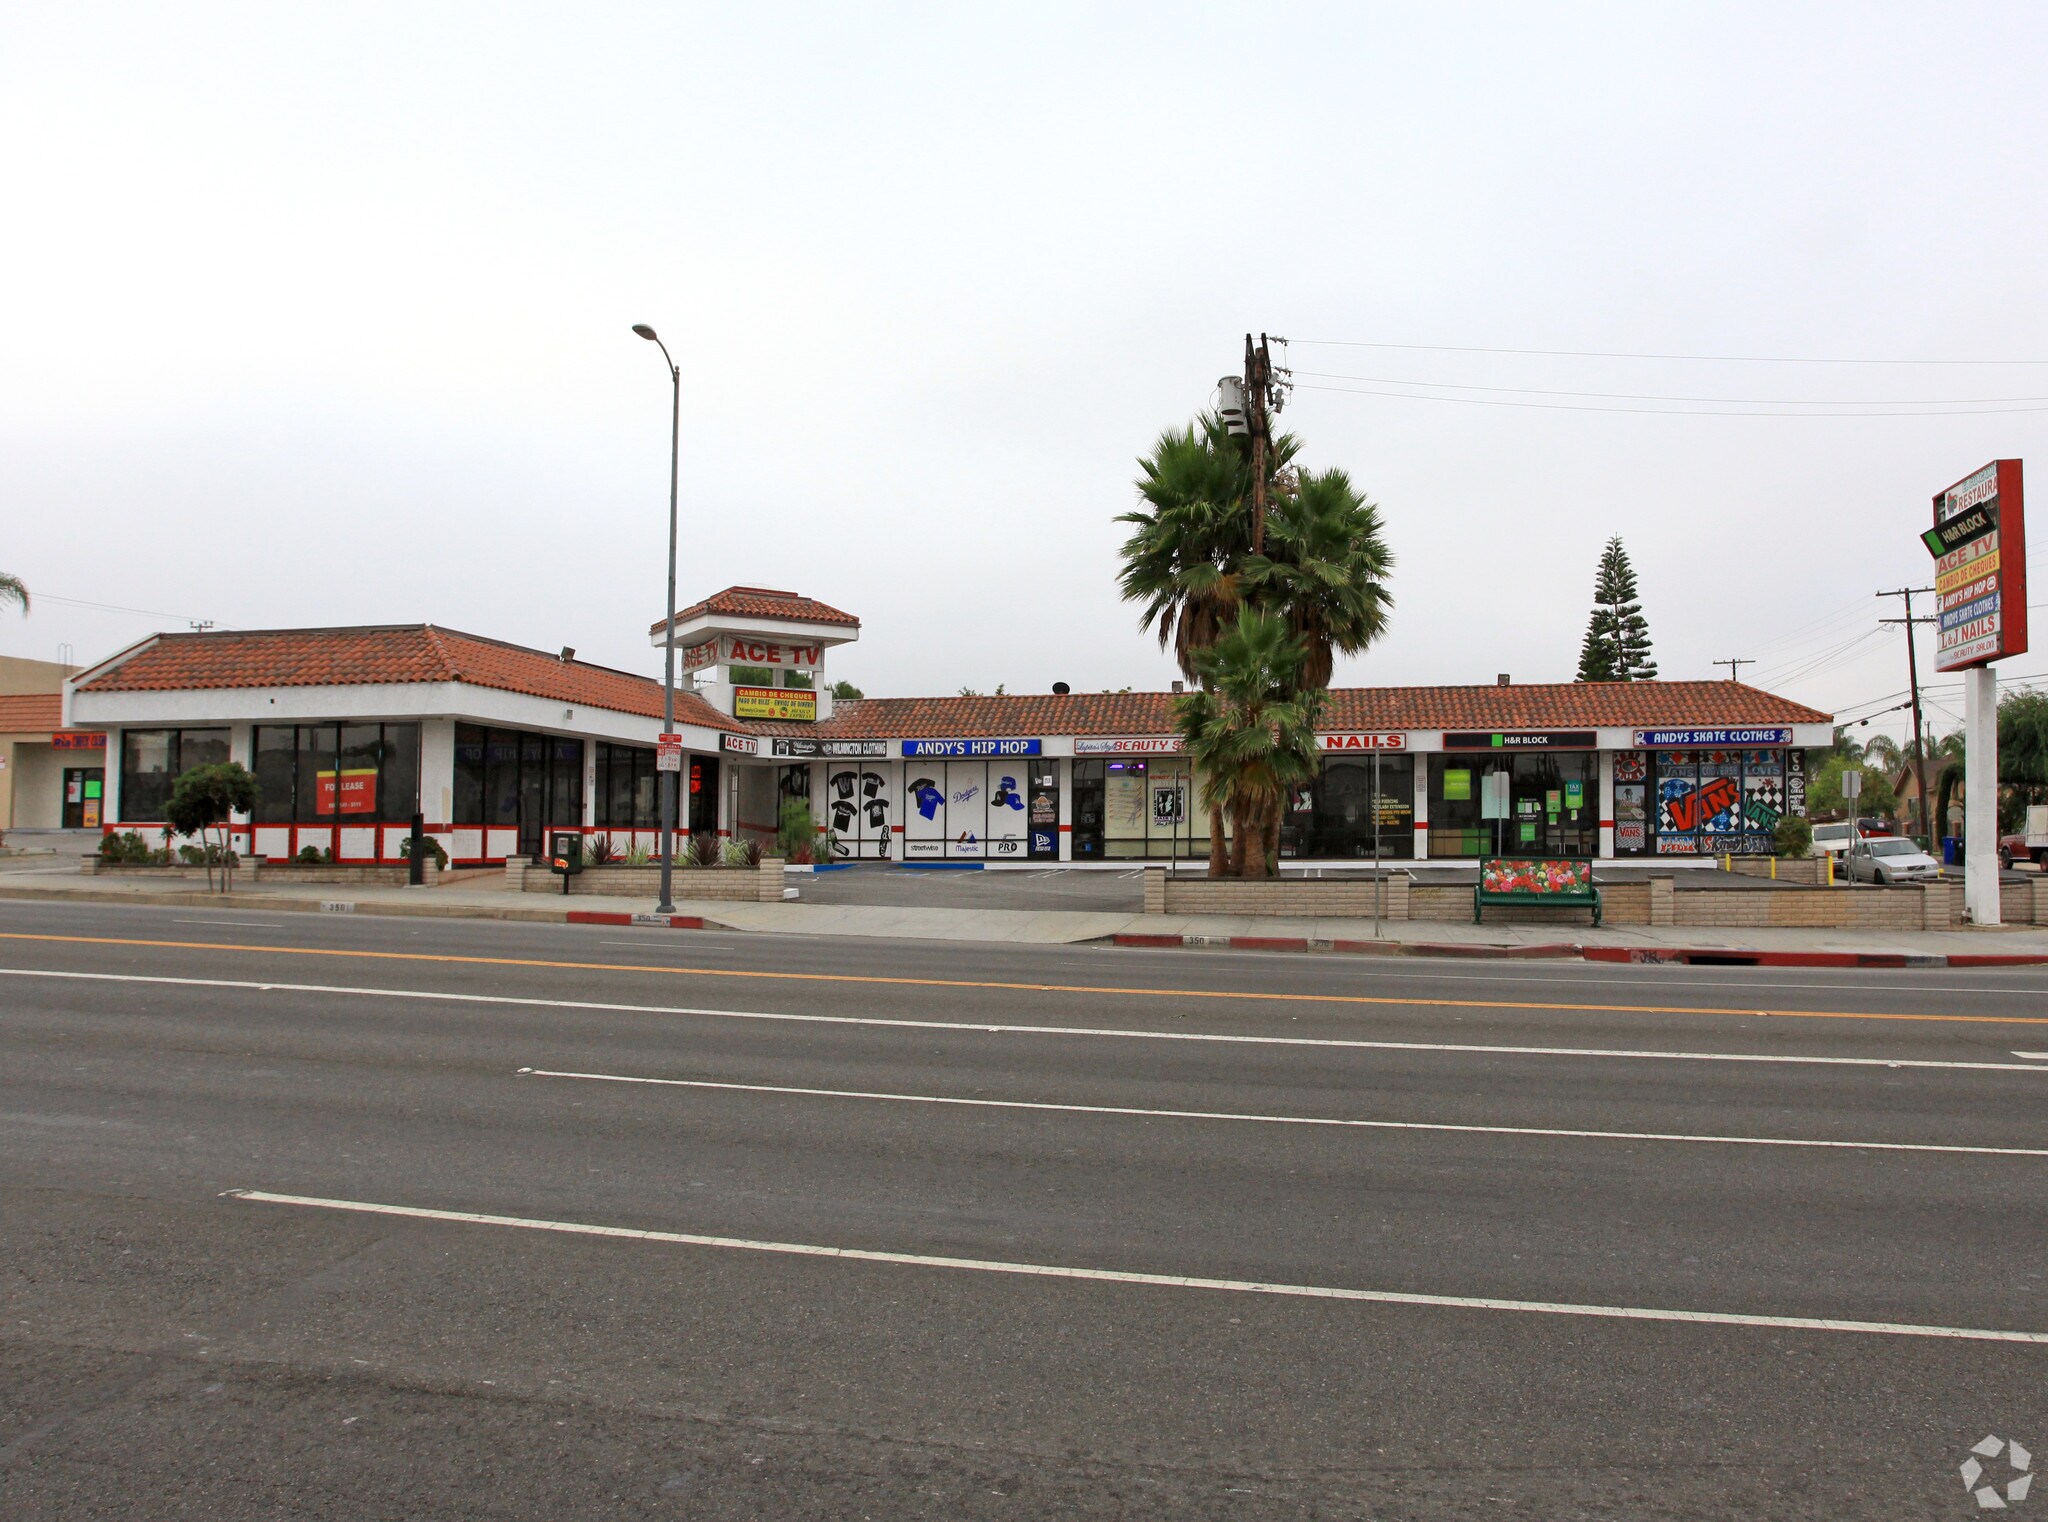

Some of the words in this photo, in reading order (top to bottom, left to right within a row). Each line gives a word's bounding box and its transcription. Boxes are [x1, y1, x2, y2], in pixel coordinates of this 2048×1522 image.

[1941, 523, 1961, 543] H&R
[1958, 512, 1987, 535] BLOCK
[1938, 547, 1968, 574] ACE
[1972, 533, 1993, 557] TV
[1939, 571, 1959, 591] CAMBIO
[1960, 568, 1968, 581] DE
[1969, 555, 1996, 578] CHEQUES
[1944, 590, 1963, 608] ANDY'S
[1963, 585, 1974, 600] HIP
[1974, 580, 1986, 596] HOP
[1961, 615, 1995, 642] NAILS
[683, 646, 703, 670] ACE
[705, 640, 719, 662] TV
[730, 640, 781, 663] ACE
[789, 646, 820, 666] TV
[1954, 645, 1974, 660] BEAUTY
[1976, 640, 1994, 653] SALON
[739, 689, 767, 697] CAMBIO
[780, 692, 812, 700] CHEQUES
[1327, 735, 1402, 748] NAILS
[1522, 736, 1549, 744] BLOCK
[1654, 732, 1690, 744] ANDYS
[1693, 730, 1726, 742] SKATE
[1730, 730, 1776, 742] CLOTHES
[726, 737, 743, 750] ACE
[746, 740, 756, 752] TV
[833, 743, 862, 755] WILMINGTON
[863, 743, 886, 755] CLOTHING
[916, 742, 965, 755] ANDY'S
[971, 742, 995, 754] HIP
[1000, 741, 1029, 754] HOP
[1113, 740, 1169, 751] BEAUTY
[341, 782, 364, 791] LEASE
[953, 785, 980, 804] Dodgers
[1669, 778, 1740, 831] VANS
[1745, 796, 1778, 830] VANS
[1620, 827, 1641, 837] VANS
[955, 844, 979, 853] Majestic
[998, 843, 1018, 852] PRO
[1189, 936, 1205, 945] 350
